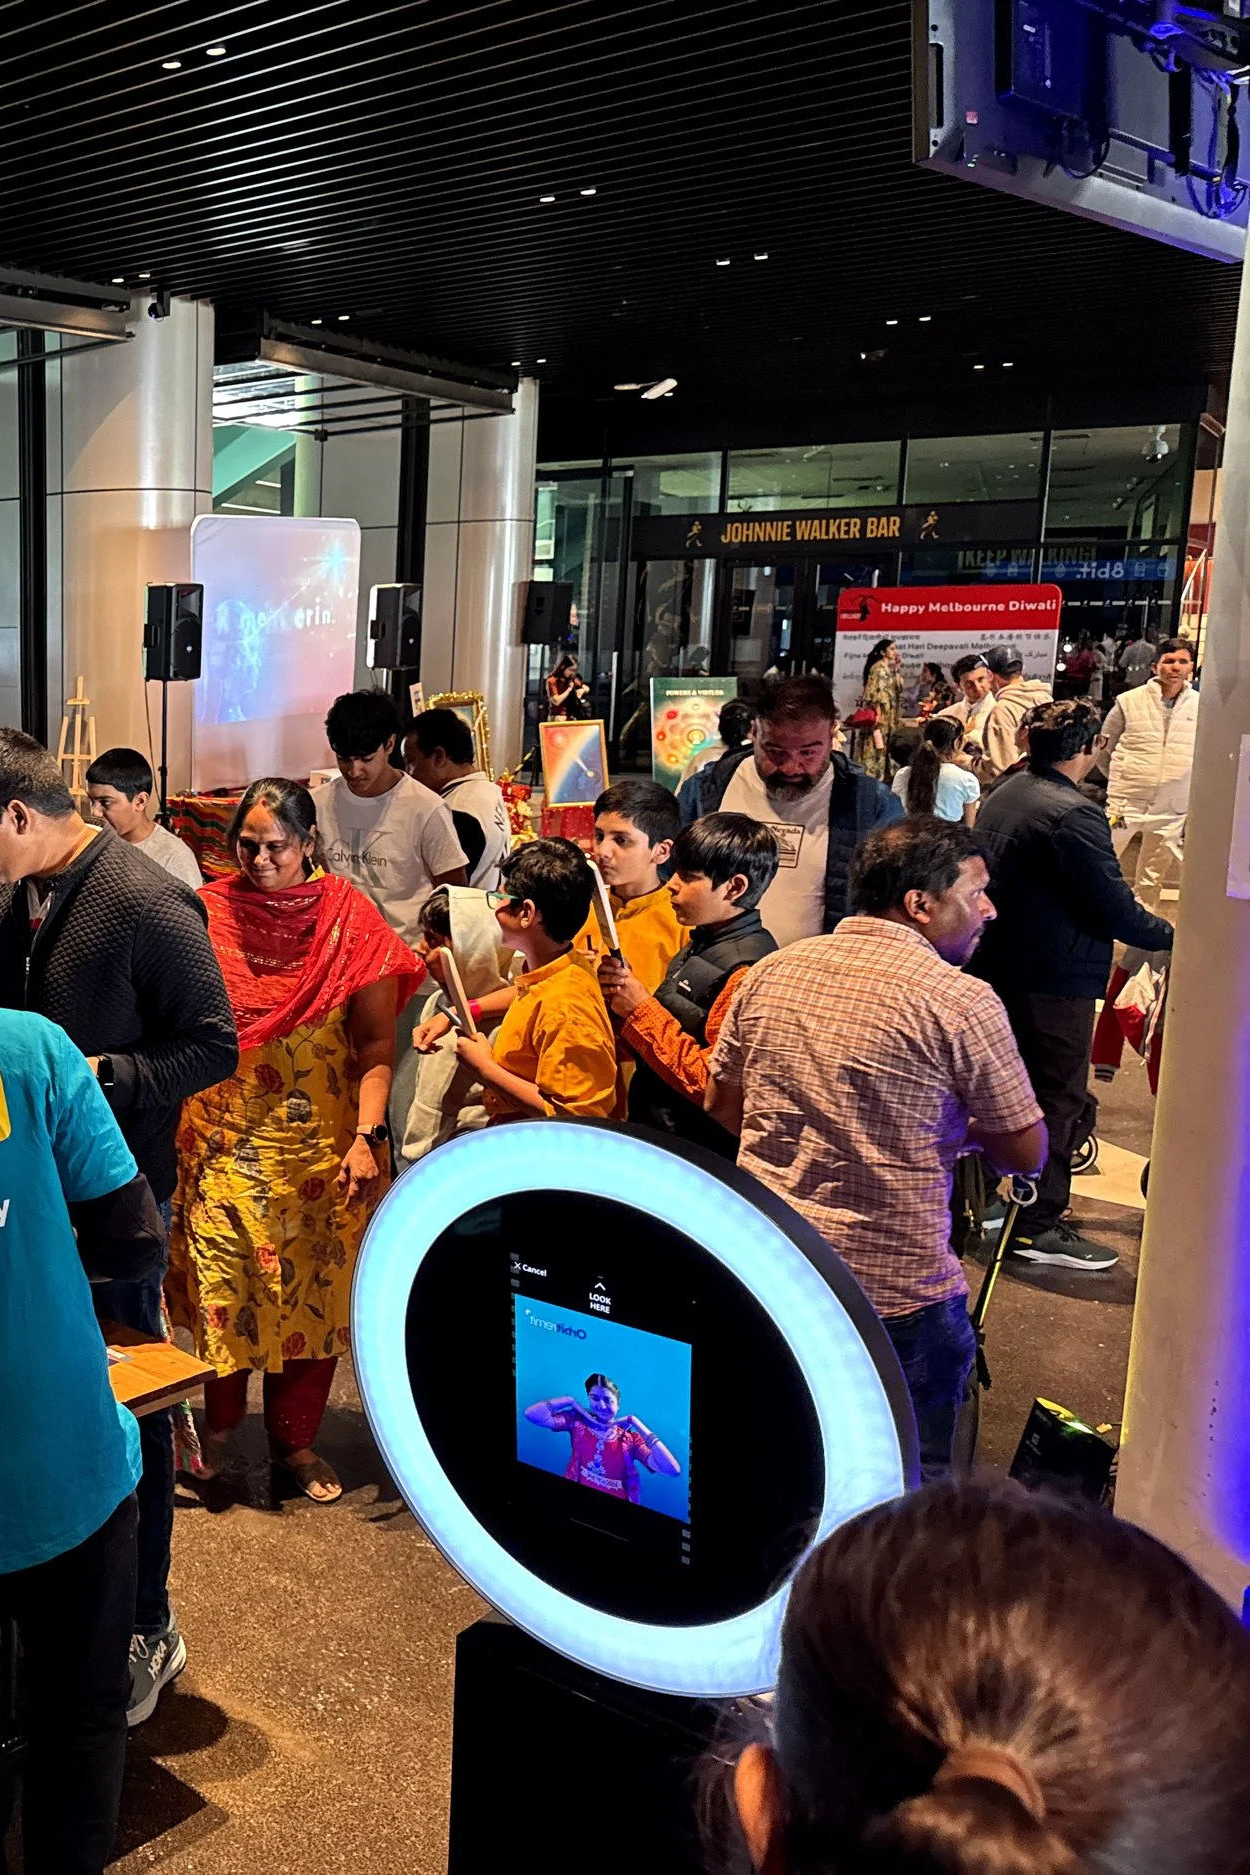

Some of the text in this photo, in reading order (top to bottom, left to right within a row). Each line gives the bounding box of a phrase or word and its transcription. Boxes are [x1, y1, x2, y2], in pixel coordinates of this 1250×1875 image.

[721, 516, 901, 543] JOHNNIE WALKER BAR
[881, 599, 1058, 615] Happy Melbourne Diwali
[326, 848, 387, 867] Calvin Klein
[522, 1264, 547, 1277] Cancel
[589, 1292, 612, 1305] LOOK
[589, 1301, 610, 1314] HERE
